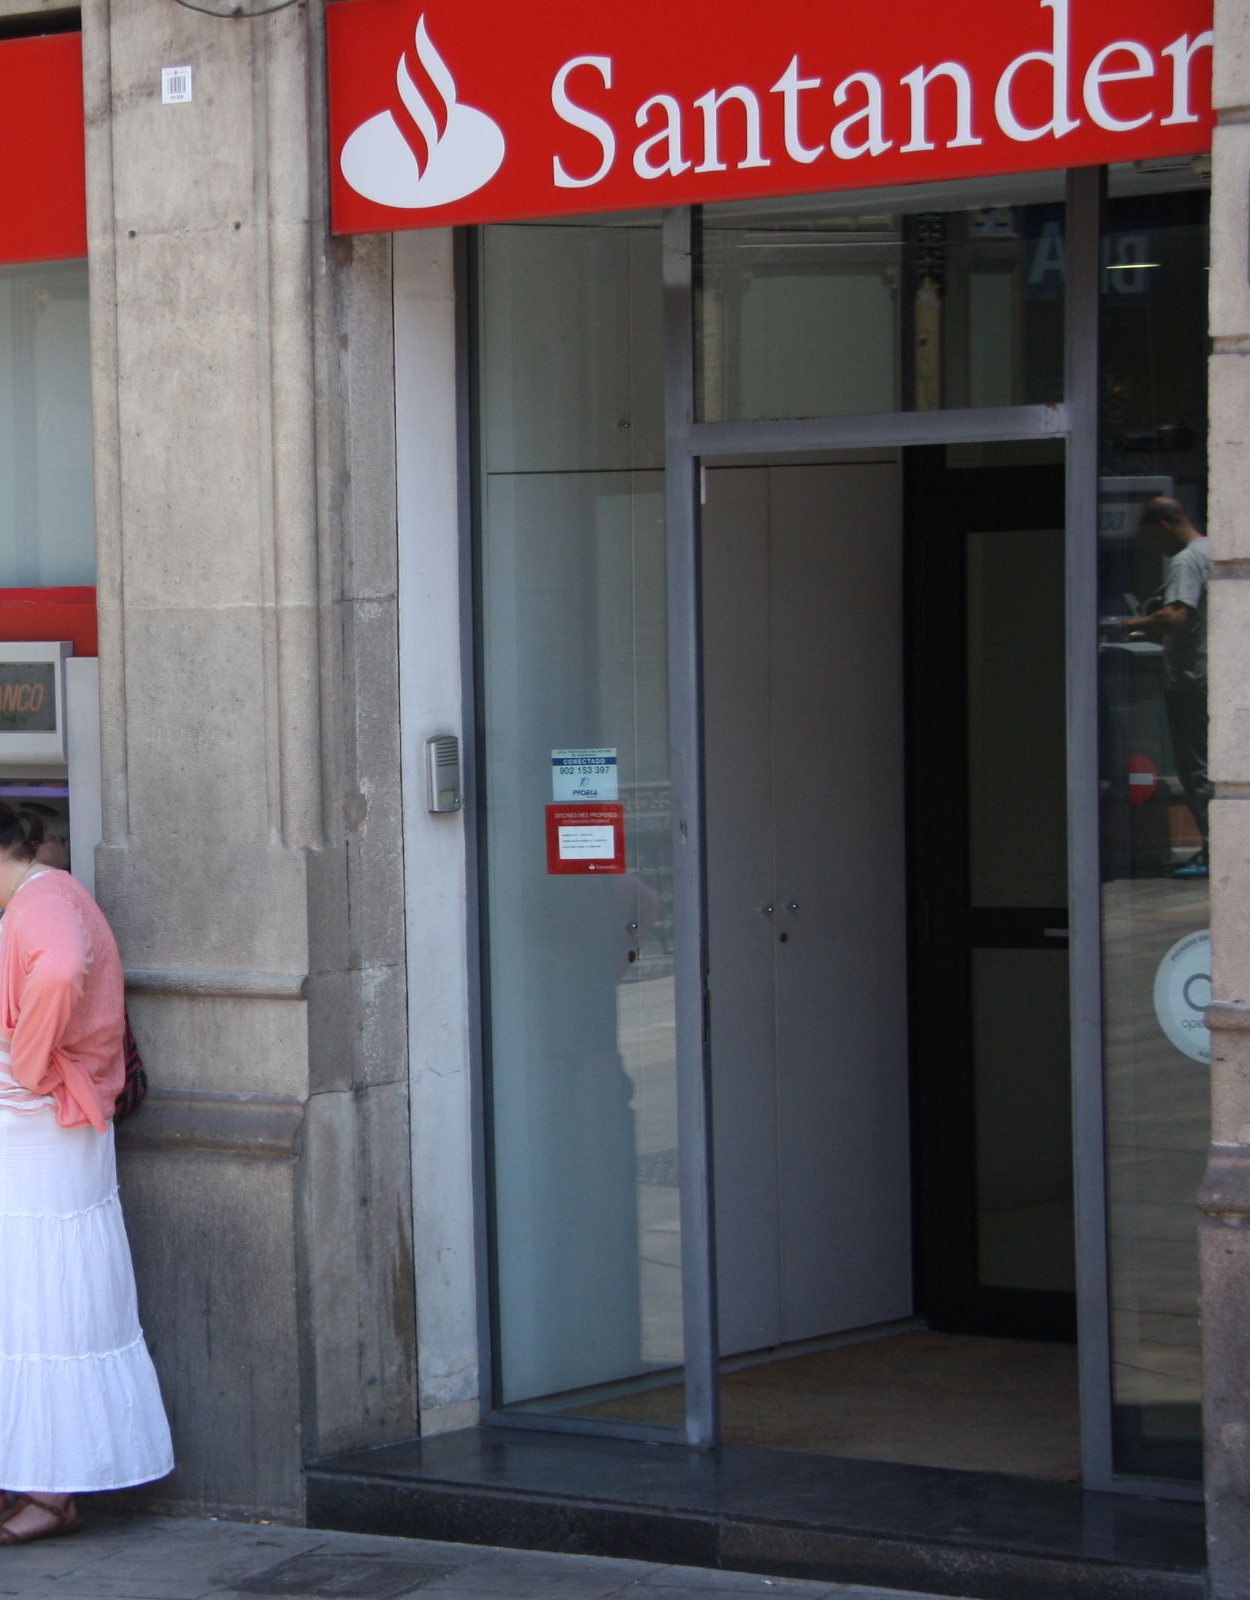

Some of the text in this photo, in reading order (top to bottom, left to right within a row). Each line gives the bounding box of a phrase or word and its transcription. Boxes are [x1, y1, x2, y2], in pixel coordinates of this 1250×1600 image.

[551, 0, 1213, 188] Santander
[559, 766, 610, 775] 902 153 397
